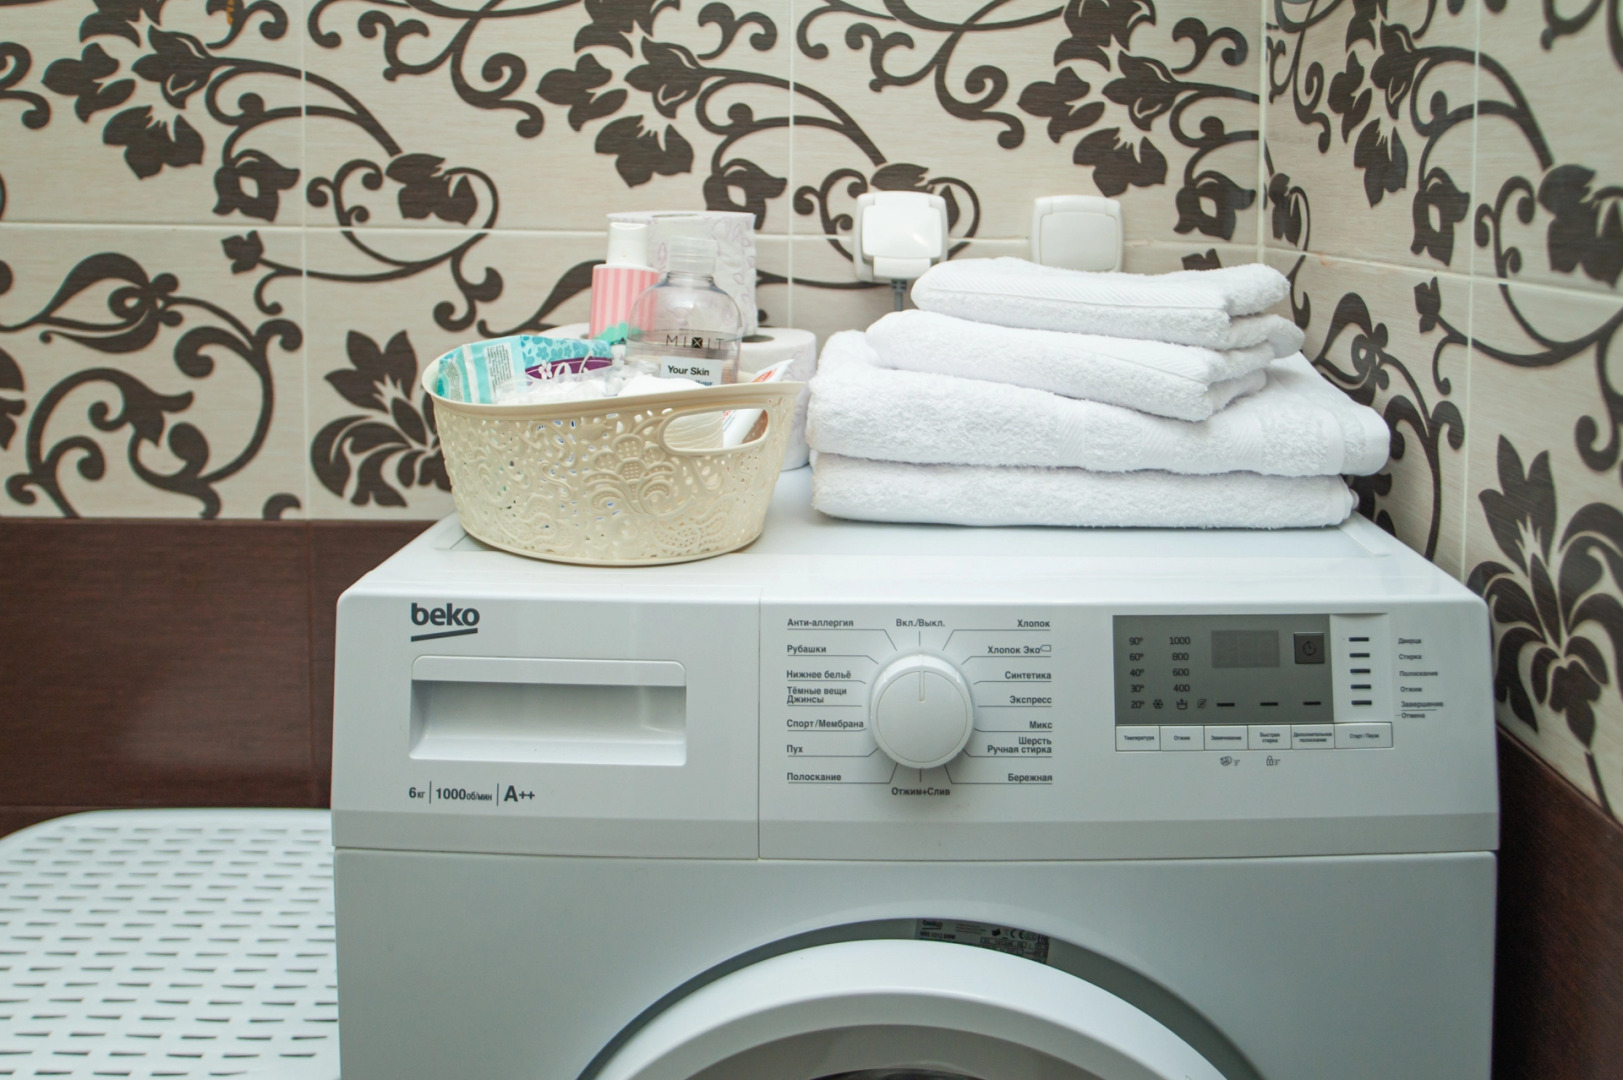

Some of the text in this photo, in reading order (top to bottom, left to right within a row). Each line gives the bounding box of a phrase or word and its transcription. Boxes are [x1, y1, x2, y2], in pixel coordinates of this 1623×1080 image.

[668, 365, 710, 376] Your Skin
[411, 603, 480, 626] beko
[787, 618, 854, 628] Анти-аллергия
[896, 619, 945, 627] Вкл./Выкл.
[1017, 620, 1050, 628] Хлопок
[1169, 637, 1191, 645] 1000
[787, 645, 827, 654] Рубашки
[988, 645, 1040, 654] Хлопок Эко
[1172, 653, 1189, 661] 800
[786, 670, 851, 679] Нижнее бельё
[1005, 671, 1051, 680] Синтетика
[787, 686, 821, 695] Тёмные
[1173, 684, 1190, 692] 400
[787, 695, 824, 704] Джинсы
[1010, 696, 1052, 704] Экспресс
[1029, 721, 1052, 729] Микс
[1018, 737, 1052, 745] Шерсть
[787, 745, 803, 754] Пух
[987, 745, 1052, 754] Ручная стирка
[787, 773, 841, 781] Полоскание
[1008, 773, 1053, 782] Бережная
[504, 785, 535, 802] A++
[891, 787, 950, 796] Отжим+Слив
